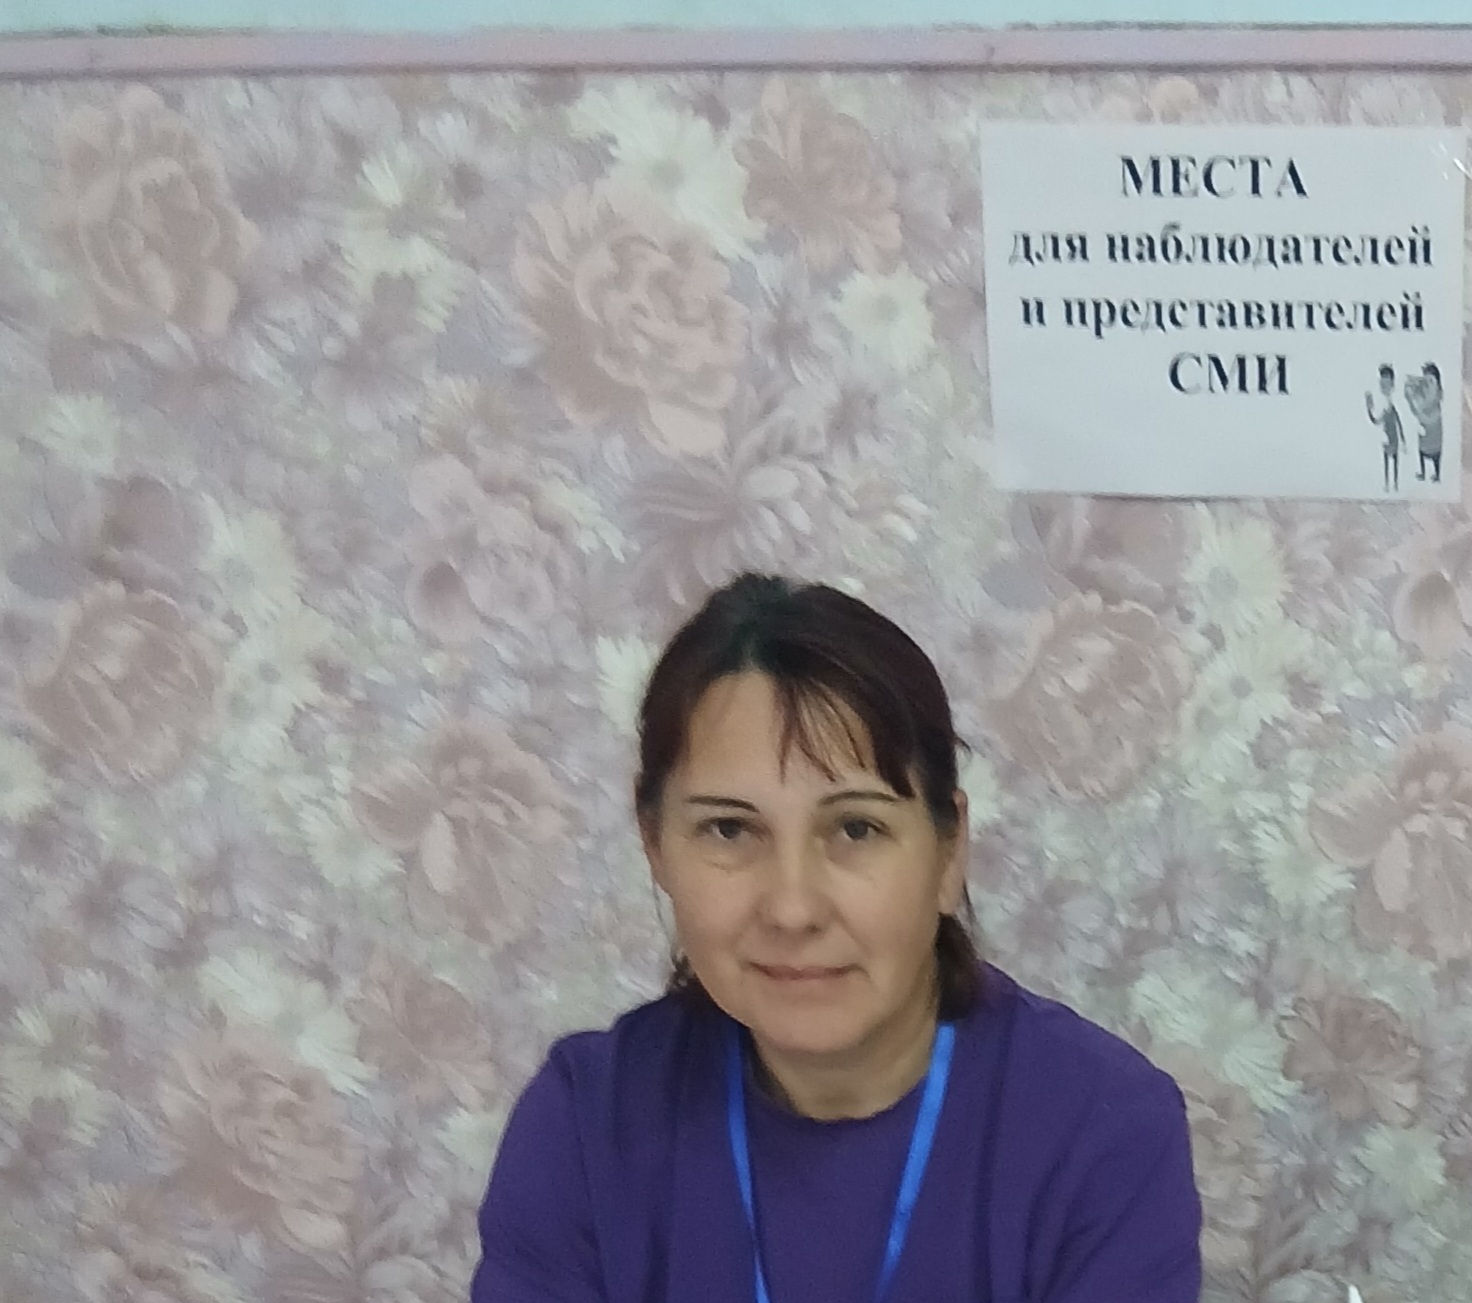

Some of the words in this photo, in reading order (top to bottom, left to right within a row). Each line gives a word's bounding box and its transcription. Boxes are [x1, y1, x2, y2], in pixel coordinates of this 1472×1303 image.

[1120, 154, 1309, 199] МЕСТА
[1008, 232, 1090, 267] для
[1105, 221, 1433, 270] наблюдателей
[1020, 296, 1047, 327] и
[1062, 290, 1425, 340] представителей
[1168, 352, 1289, 396] СМИ
